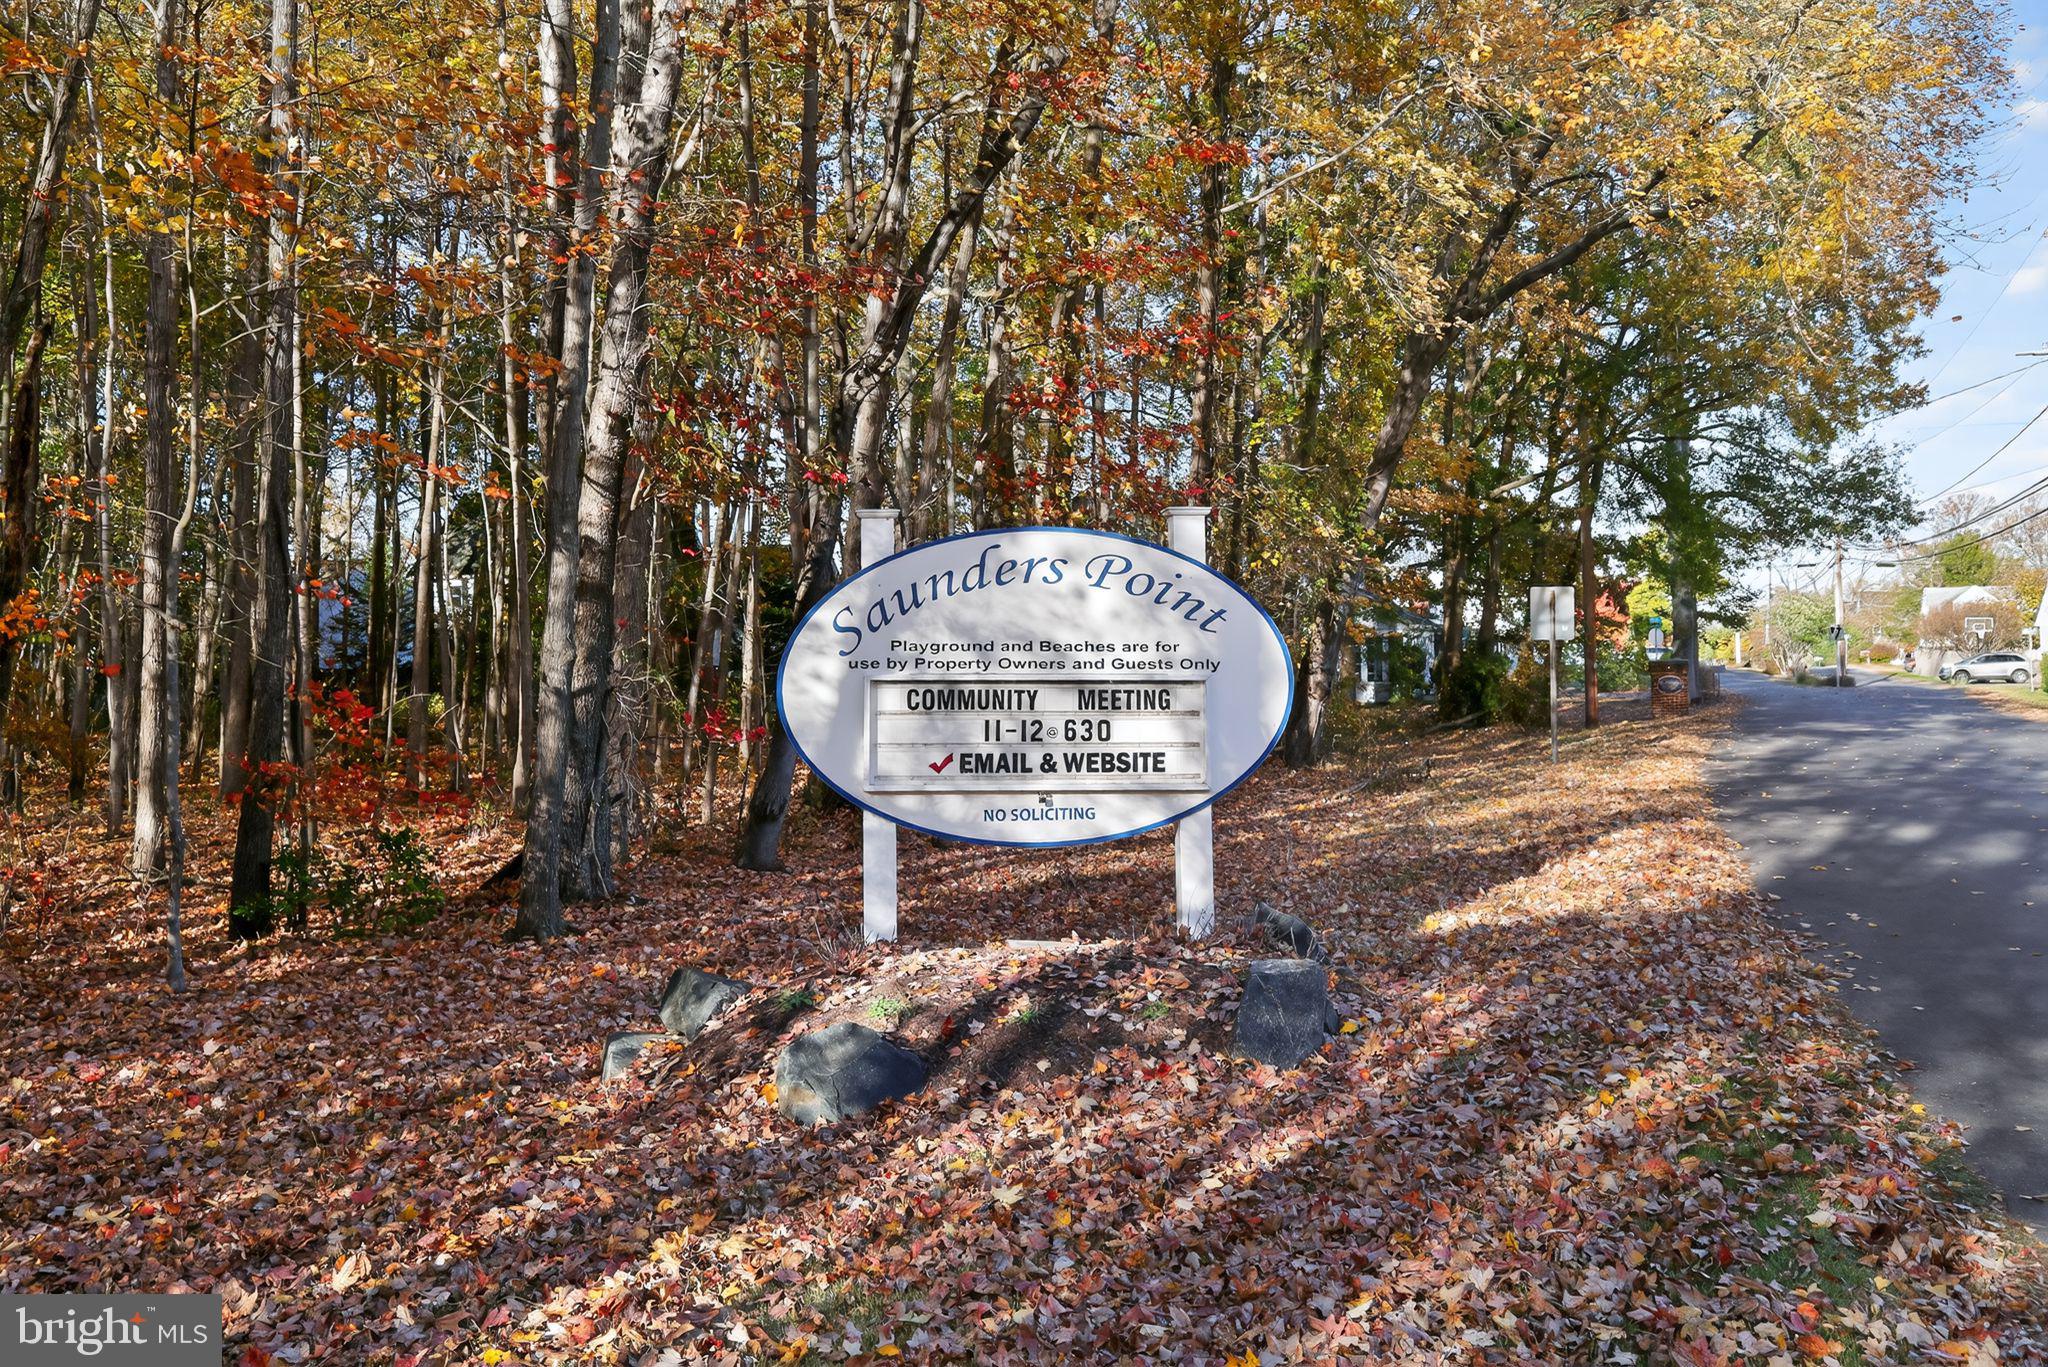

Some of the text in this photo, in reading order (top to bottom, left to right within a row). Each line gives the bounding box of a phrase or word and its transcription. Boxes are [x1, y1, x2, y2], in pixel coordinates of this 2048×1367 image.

[832, 543, 1228, 657] Saunders Point
[890, 640, 1180, 655] Playground and Beaches are for
[848, 657, 1221, 673] use by Property Owners and Guests Only
[906, 688, 1171, 711] COMMUNITY MEETING
[1064, 718, 1112, 742] 630
[959, 752, 1166, 774] EMAIL & WEBSITE
[983, 807, 1096, 822] NO SOLICITING
